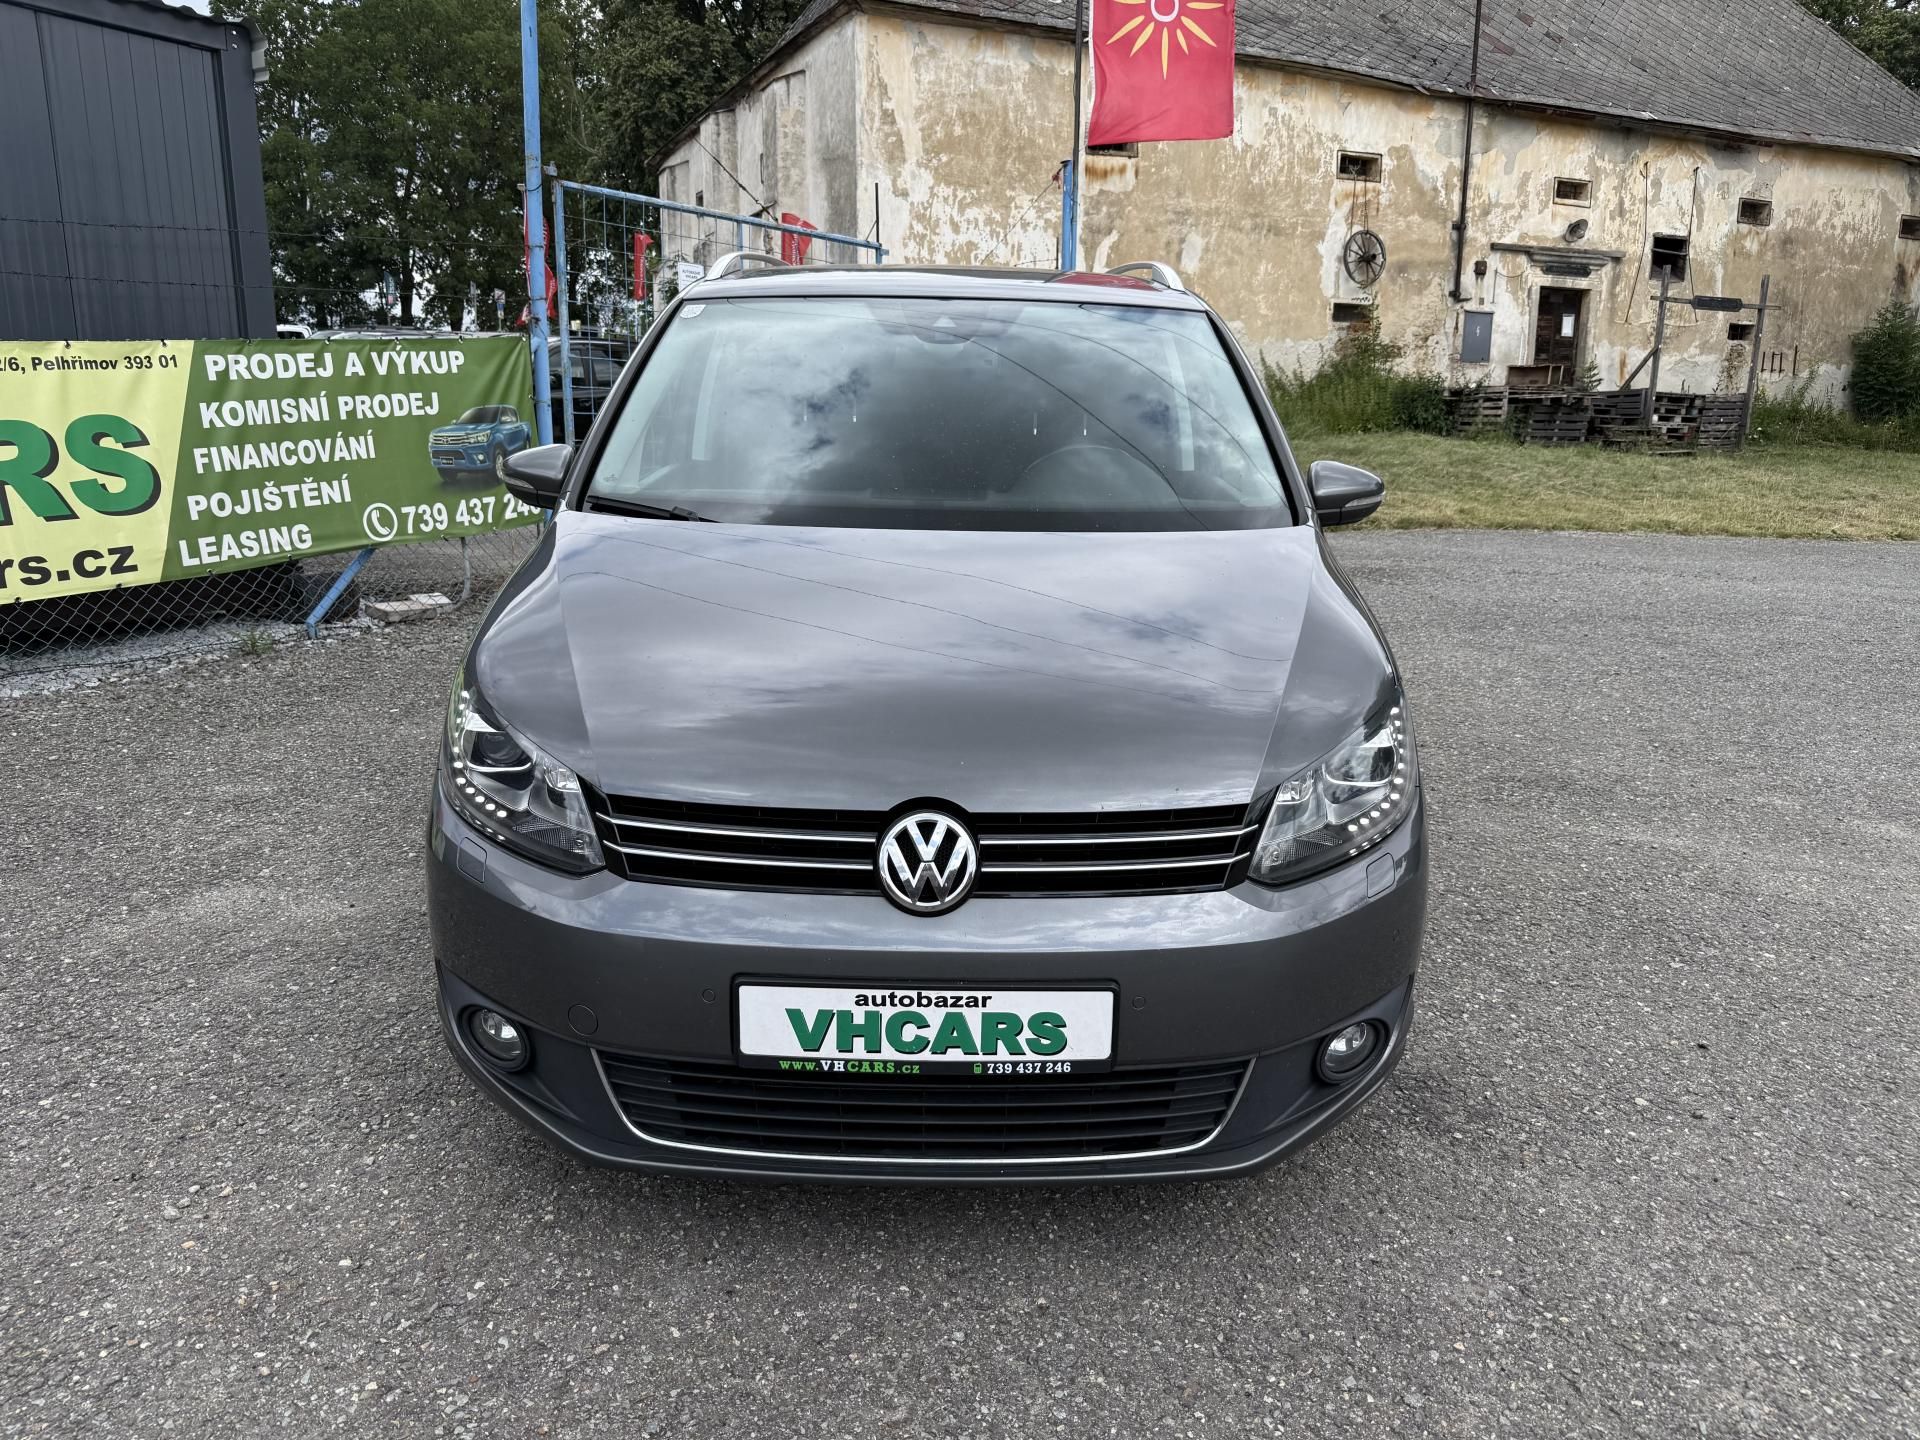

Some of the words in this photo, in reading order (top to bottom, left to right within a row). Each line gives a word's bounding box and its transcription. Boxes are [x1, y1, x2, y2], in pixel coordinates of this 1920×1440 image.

[31, 355, 118, 371] Pelhřimov
[124, 355, 153, 370] 393
[158, 354, 178, 369] 01
[205, 352, 334, 381] PRODEJ
[344, 352, 366, 377] A
[371, 345, 465, 376] VÝKUP
[199, 391, 330, 429] KOMISNÍ
[338, 391, 439, 420] PRODEJ
[193, 430, 376, 474] FINANCOVÁNÍ
[187, 474, 352, 521] POJIŠTĚNÍ
[401, 503, 449, 534] 739
[456, 496, 495, 527] 437
[179, 524, 313, 567] LEASING
[882, 815, 973, 908] VW
[855, 992, 993, 1009] autobazar
[785, 1008, 1068, 1057] VHCARS
[779, 1060, 920, 1074] www.VHCARS.cz
[986, 1062, 1013, 1074] 739
[1016, 1062, 1042, 1074] 437
[1045, 1061, 1072, 1073] 246
